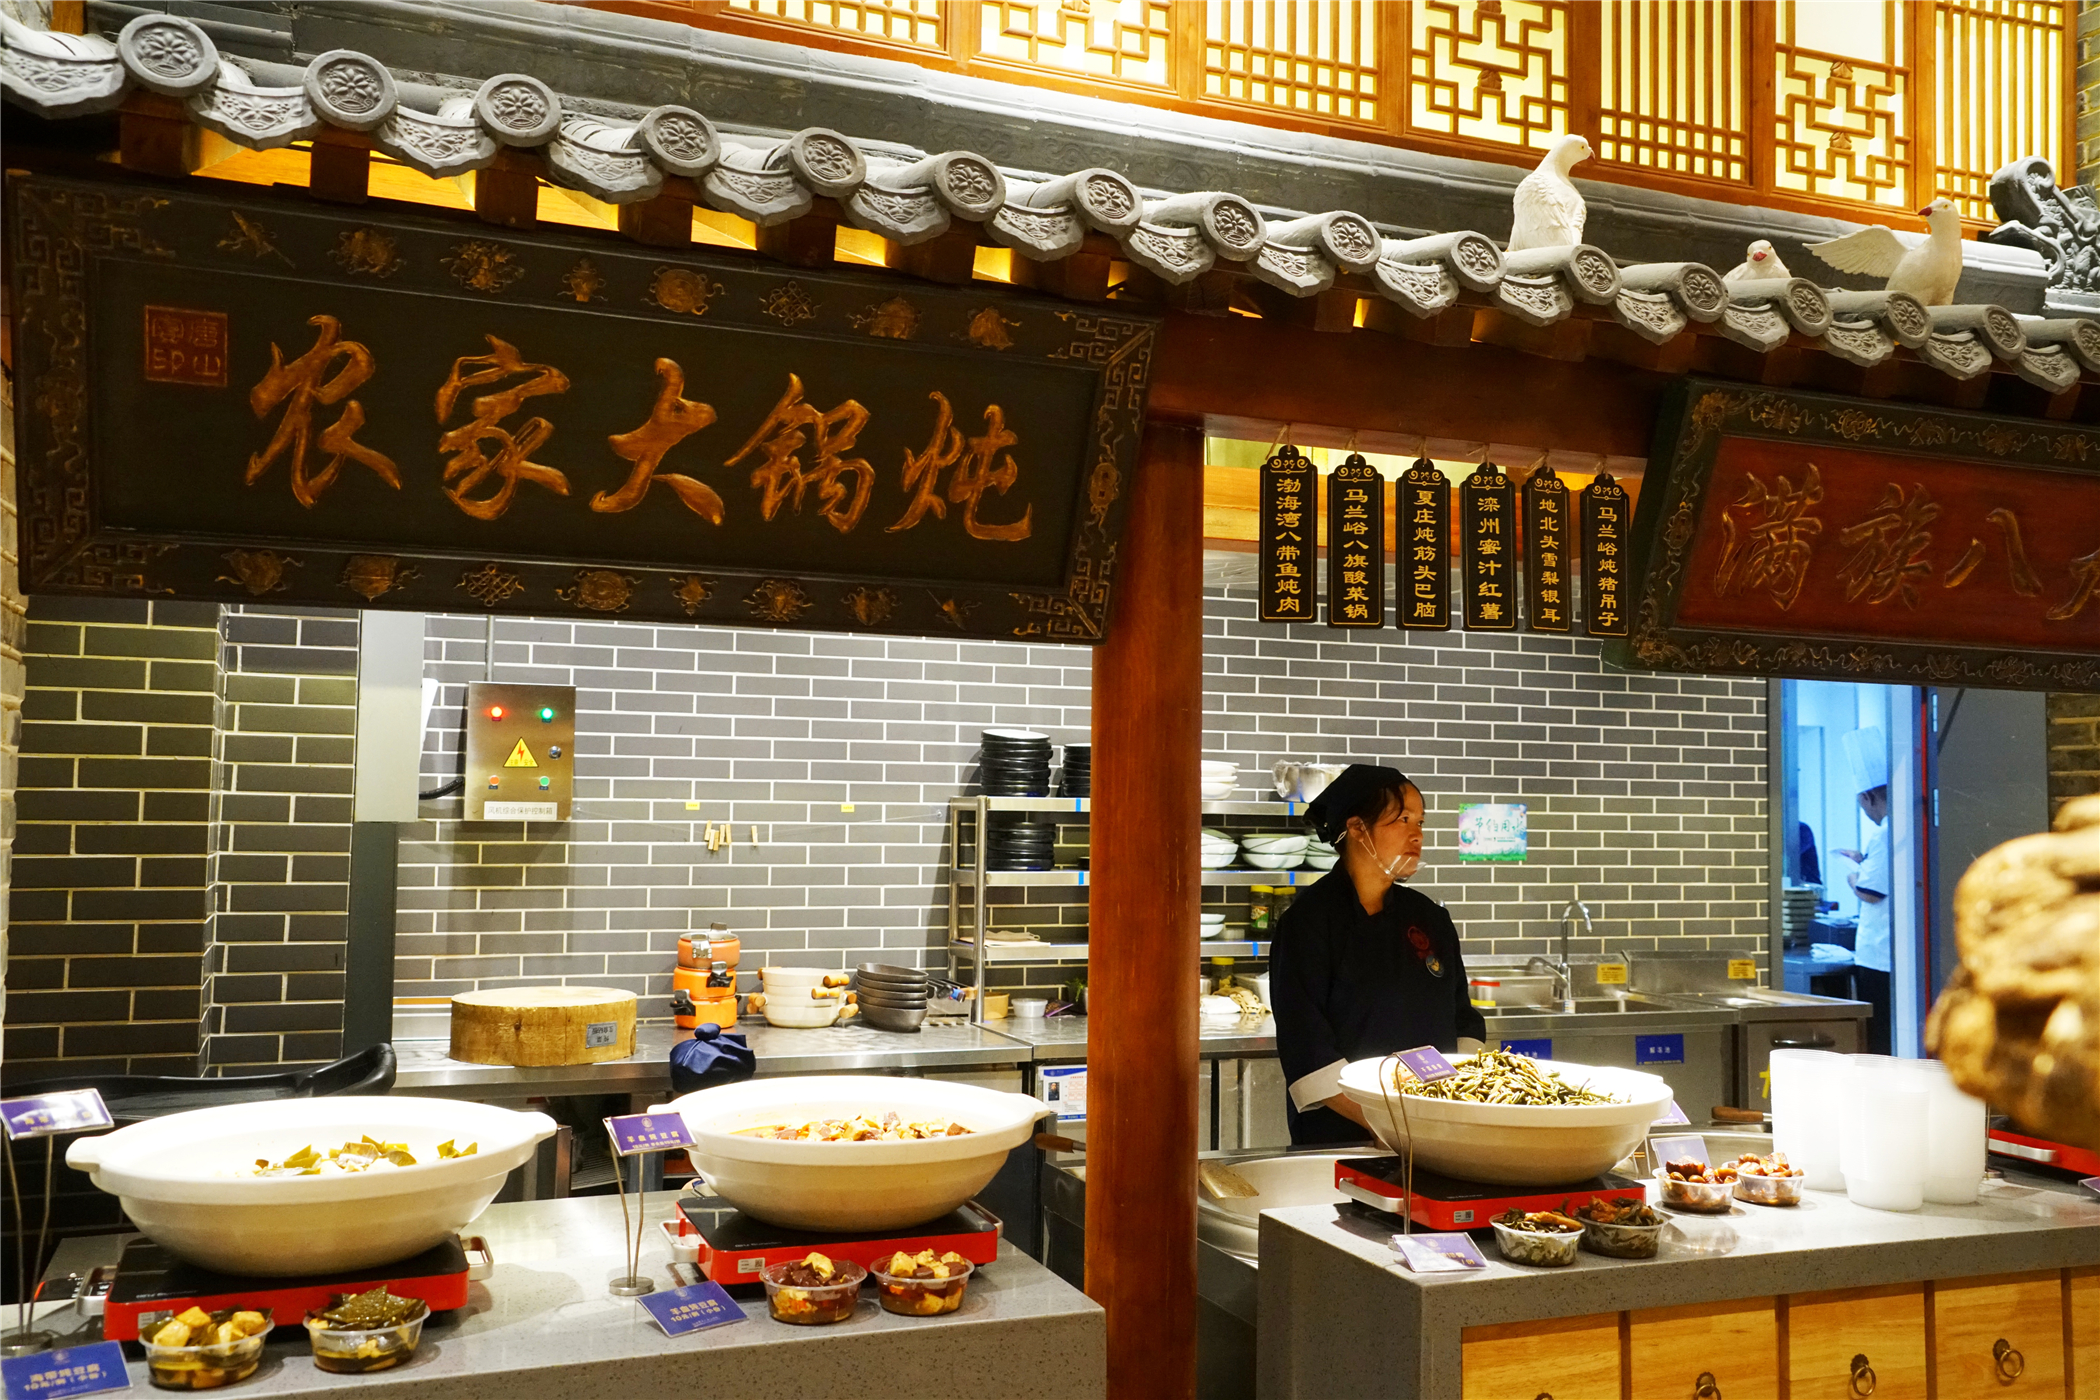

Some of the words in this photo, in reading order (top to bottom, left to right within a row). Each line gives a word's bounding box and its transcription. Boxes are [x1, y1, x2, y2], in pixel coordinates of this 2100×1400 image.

[245, 312, 1033, 542] 农家大锅炖
[1274, 477, 1302, 613] 渤海湾八带鱼炖肉
[1343, 488, 1370, 619] 马兰峪八旗酸菜锅
[1413, 489, 1437, 618] 夏庄炖筋头巴脑
[1477, 496, 1503, 620] 滦州蜜汁红薯
[1539, 498, 1561, 623] 地北头雪梨银耳
[1597, 506, 1619, 627] 马兰峪炖猪吊子
[487, 806, 553, 816] 风机综合保护控制箱
